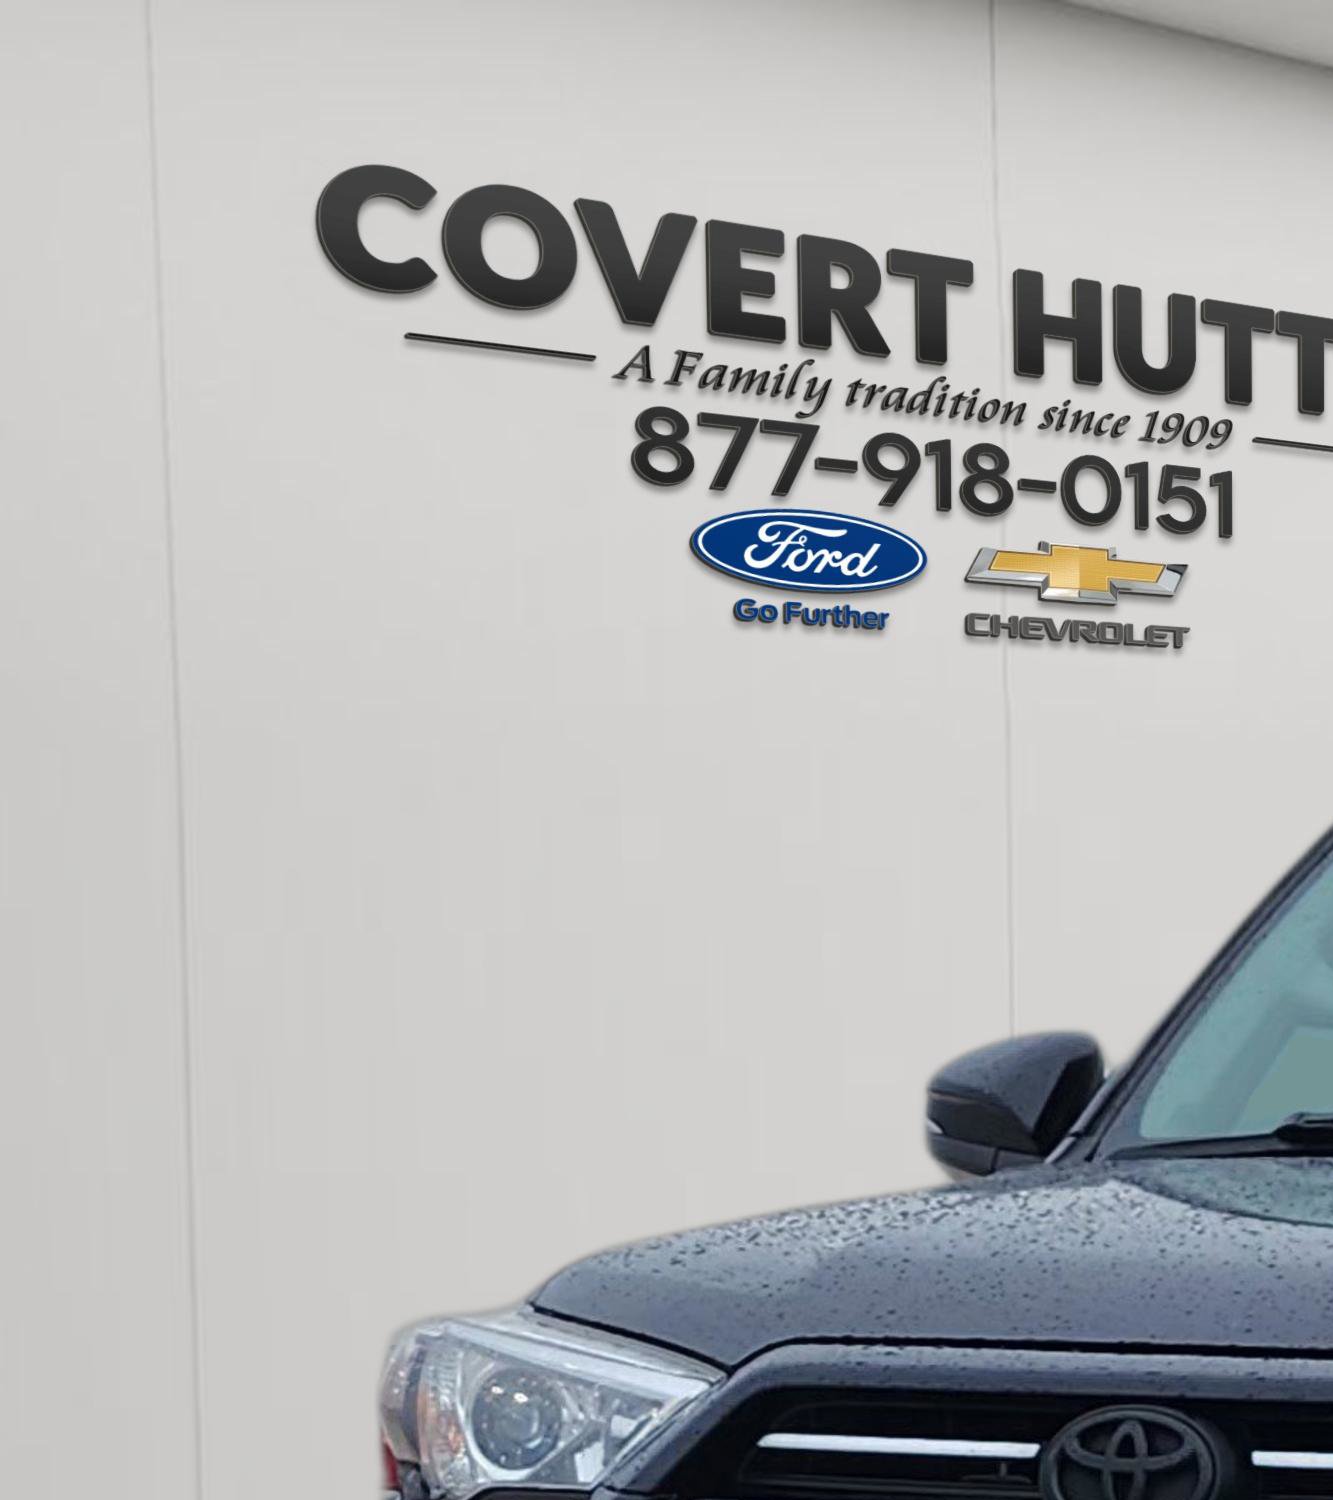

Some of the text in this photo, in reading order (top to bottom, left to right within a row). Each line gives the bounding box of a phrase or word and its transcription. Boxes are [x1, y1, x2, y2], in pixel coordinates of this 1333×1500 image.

[316, 164, 974, 367] COVERT
[611, 344, 1234, 451] A Family tradition since 1909
[630, 406, 1233, 540] 877-918-0151
[743, 520, 882, 578] Ford
[732, 598, 891, 631] Go Further
[964, 612, 1191, 650] CHEVROLET
